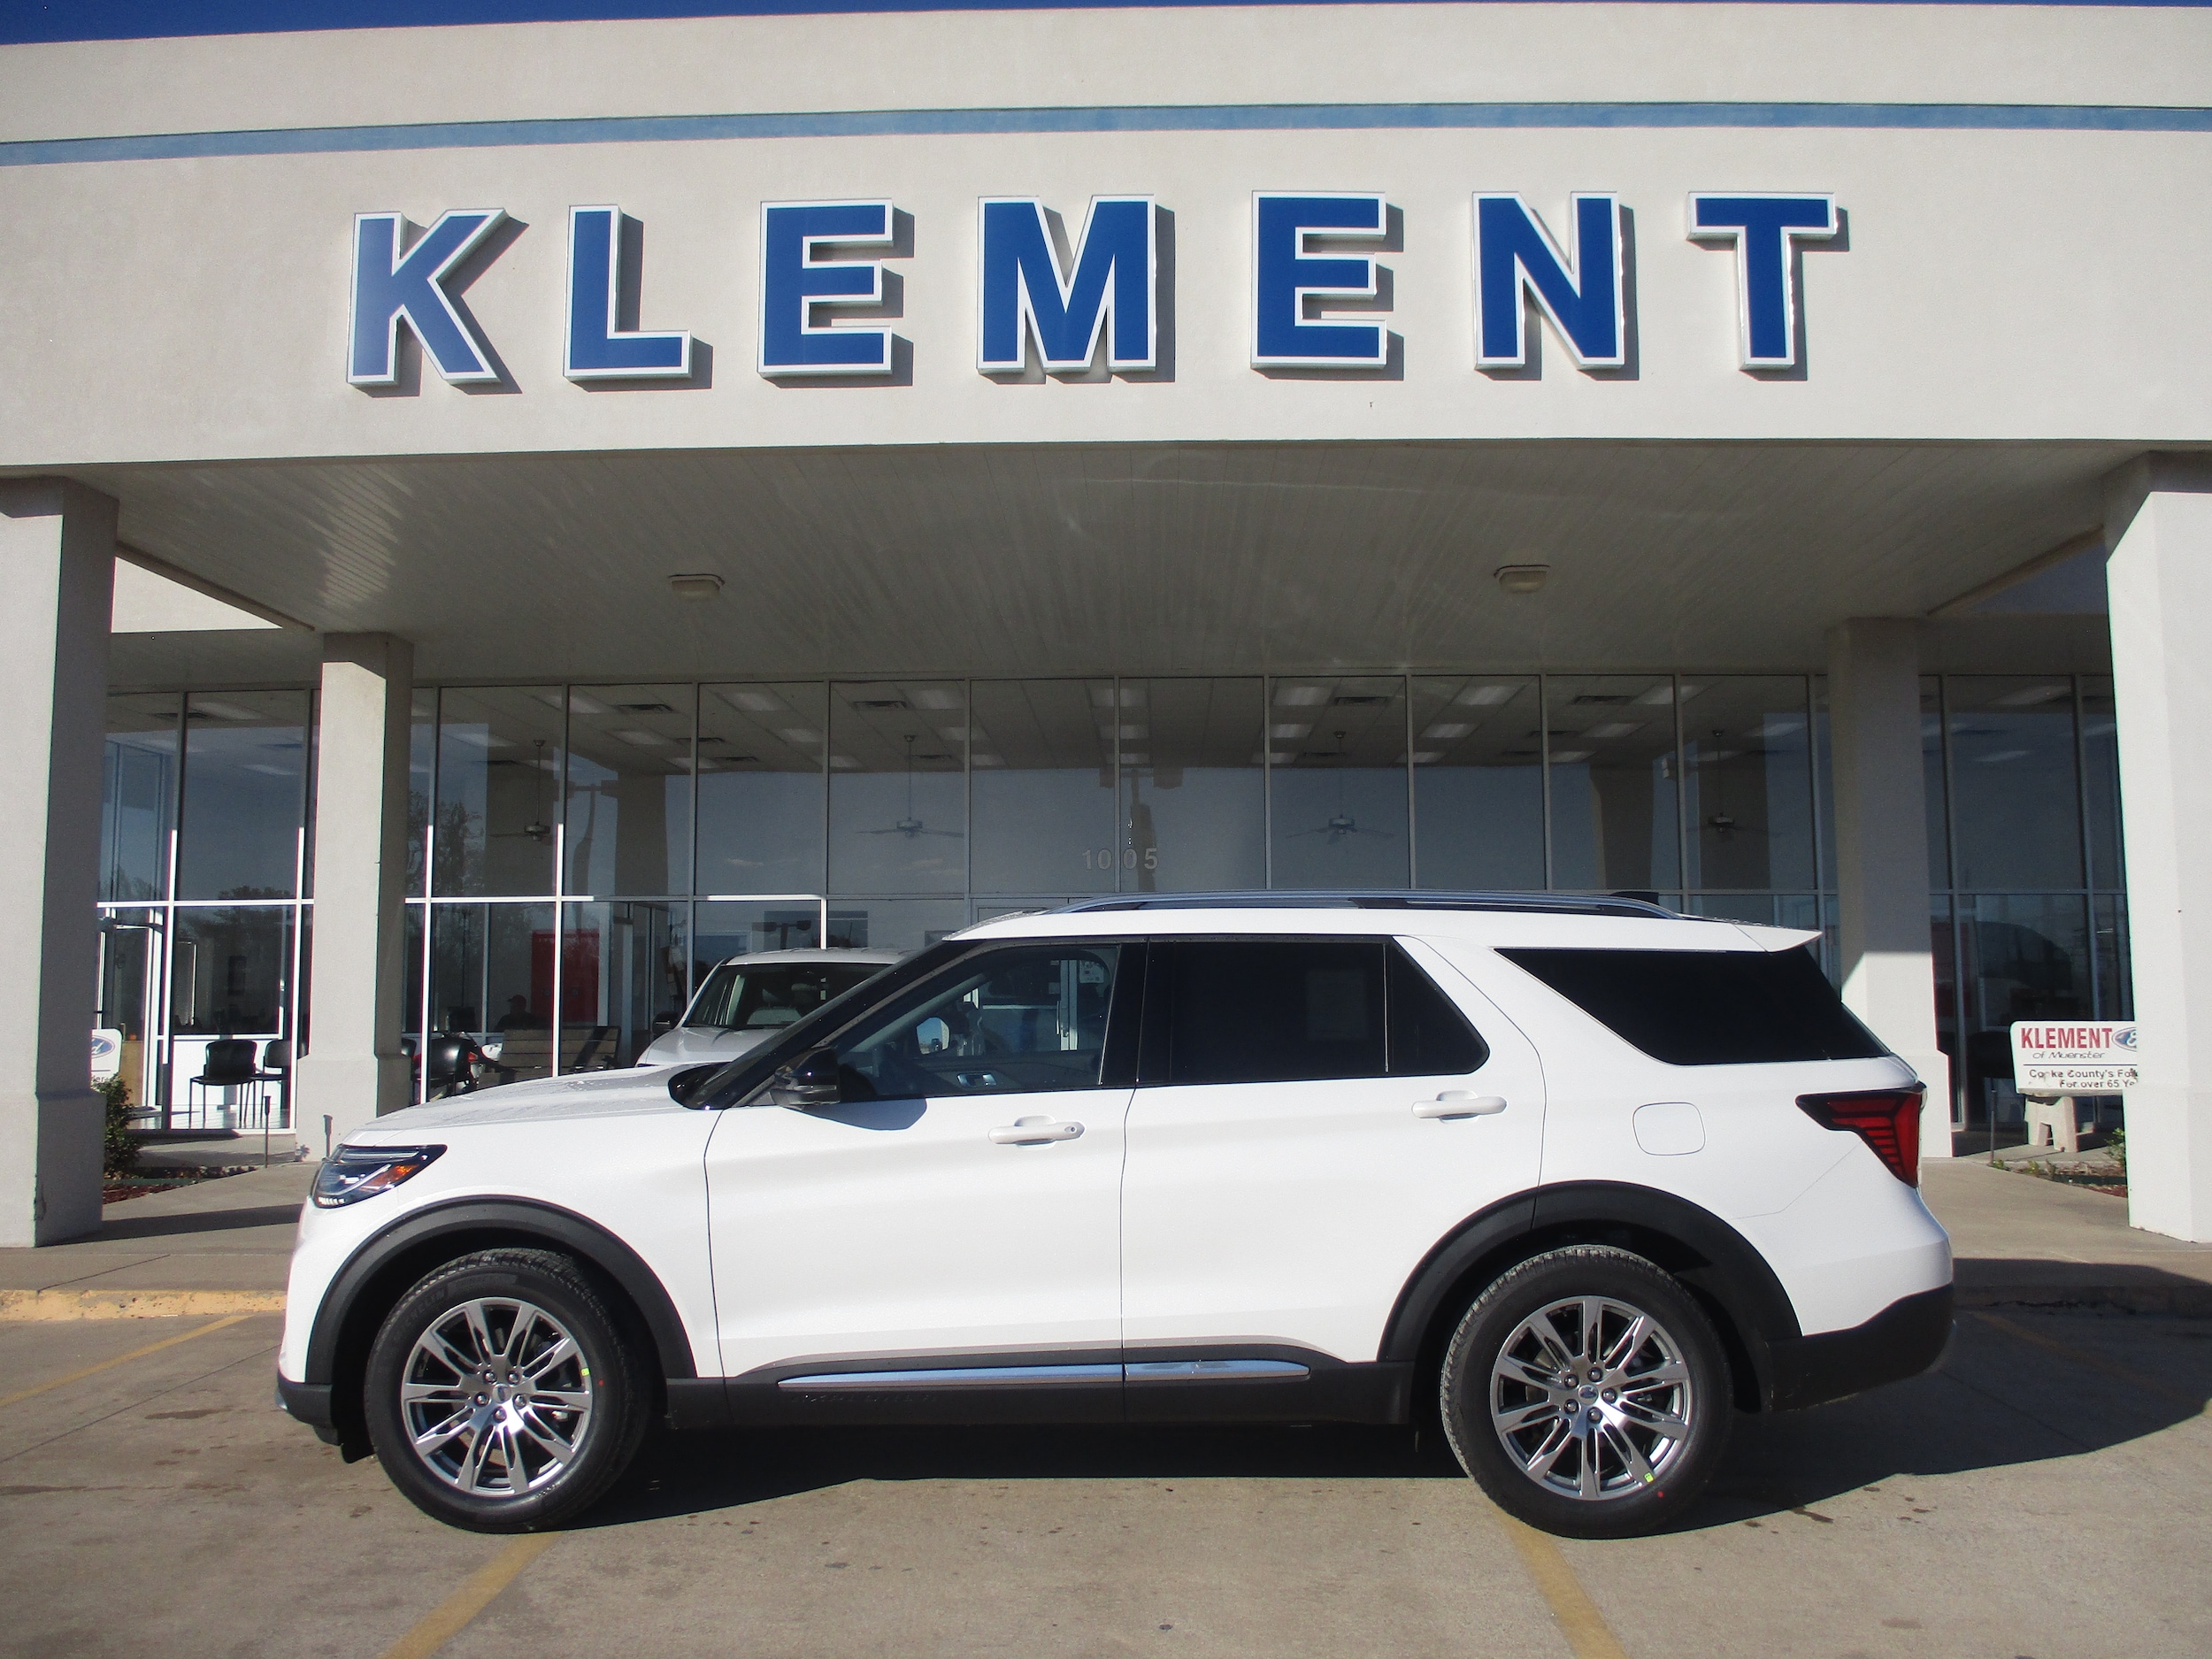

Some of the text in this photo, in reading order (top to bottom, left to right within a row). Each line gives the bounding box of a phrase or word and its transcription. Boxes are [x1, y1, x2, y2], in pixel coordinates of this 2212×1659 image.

[347, 191, 1837, 384] KLEMENT
[1082, 848, 1158, 870] 1005
[2021, 1027, 2113, 1048] KLEMENT
[2067, 1069, 2114, 1079] County's
[2107, 1079, 2119, 1088] 65
